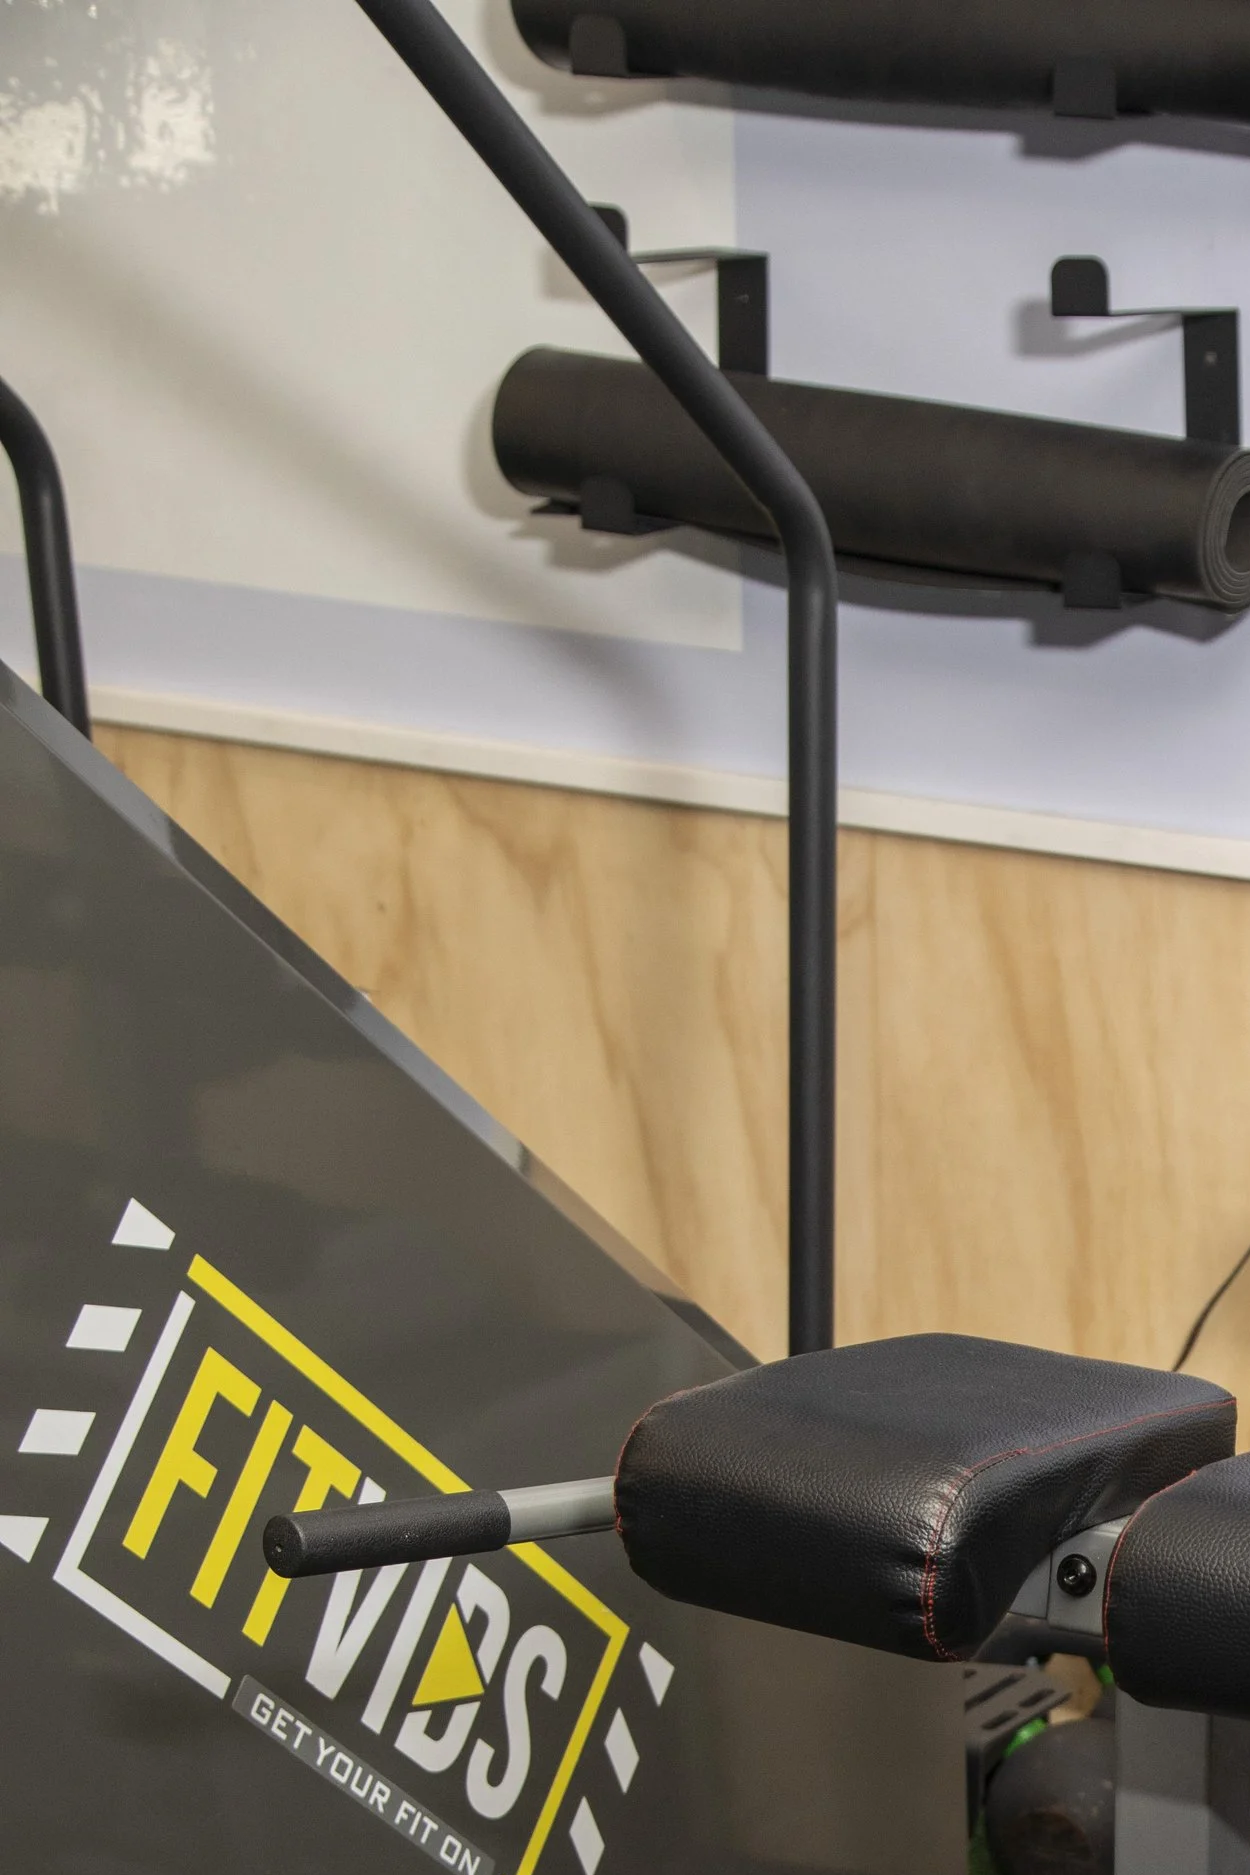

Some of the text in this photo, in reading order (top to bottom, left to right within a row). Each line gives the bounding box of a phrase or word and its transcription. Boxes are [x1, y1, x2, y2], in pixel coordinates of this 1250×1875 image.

[250, 1692, 312, 1750] GET
[316, 1736, 391, 1813] YOUR
[394, 1800, 439, 1845] FIT
